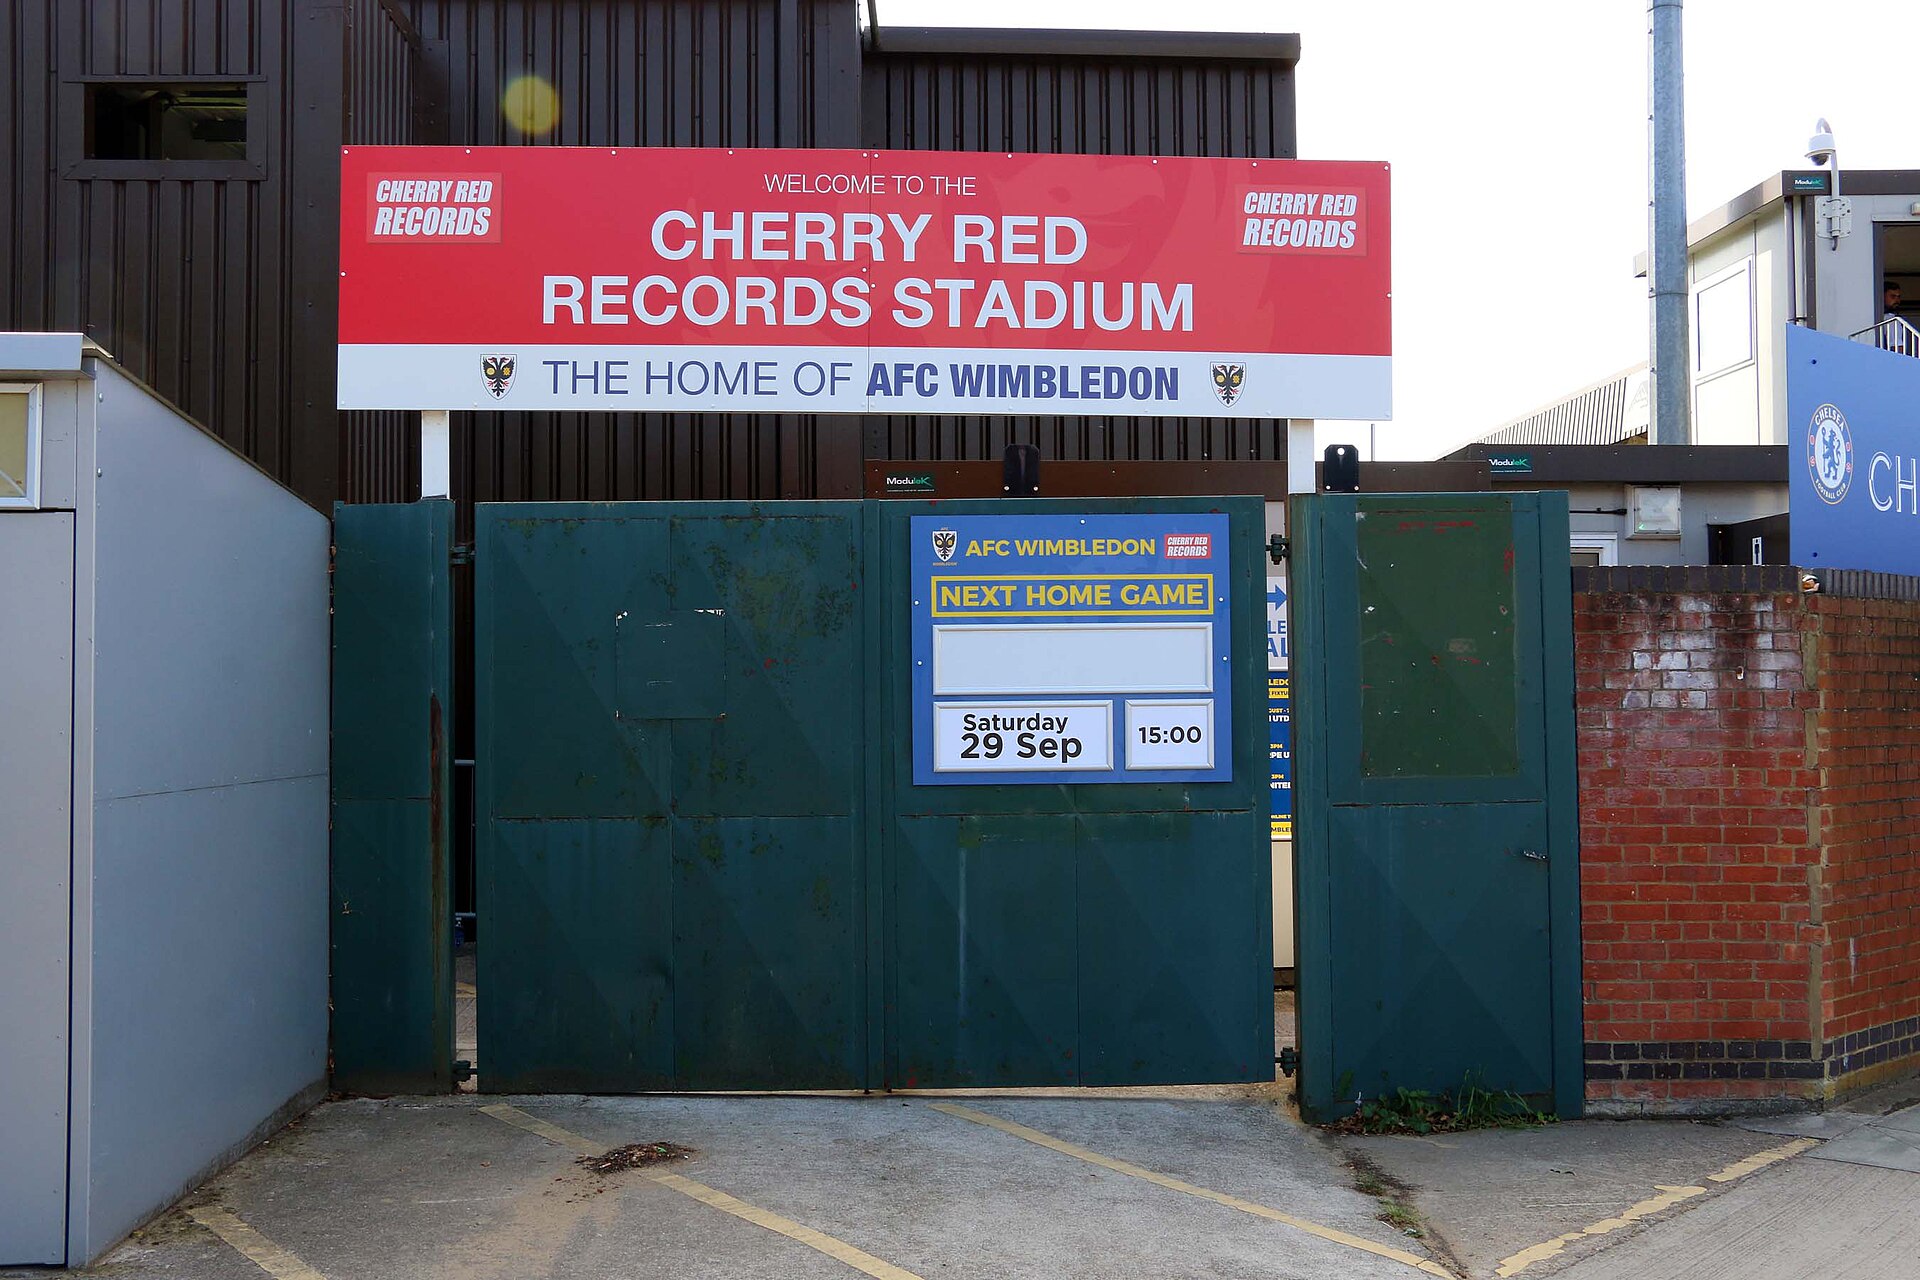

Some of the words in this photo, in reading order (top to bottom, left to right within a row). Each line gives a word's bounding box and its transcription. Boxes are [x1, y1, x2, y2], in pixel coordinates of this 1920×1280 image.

[376, 180, 453, 203] CHERRY
[454, 180, 493, 203] RED
[765, 174, 886, 193] WELCOME
[891, 176, 924, 194] TO
[930, 177, 977, 195] THE
[1243, 192, 1319, 215] CHERRY
[1320, 194, 1357, 216] RED
[374, 206, 491, 236] RECORDS
[1243, 218, 1357, 248] RECORDS
[651, 210, 931, 262] CHERRY
[953, 214, 1088, 264] RED
[542, 275, 872, 327] RECORDS
[892, 278, 1193, 332] STADIUM
[543, 361, 629, 395] THE
[646, 361, 778, 396] HOME
[793, 362, 853, 397] OF
[866, 363, 939, 398] AFC
[950, 364, 1179, 401] WIMBLEDON
[965, 539, 1009, 556] AFC
[1015, 539, 1156, 556] WIMBLEDON
[1167, 545, 1208, 557] RECORDS
[1168, 536, 1195, 546] CHERRY
[1194, 536, 1208, 545] RED
[941, 585, 1017, 607] NEXT
[1026, 584, 1111, 606] HOME
[1120, 583, 1204, 605] GAME
[963, 713, 1069, 734] Saturday
[1138, 726, 1202, 744] 15:00
[960, 732, 1003, 759] 29
[1016, 732, 1082, 763] Sep
